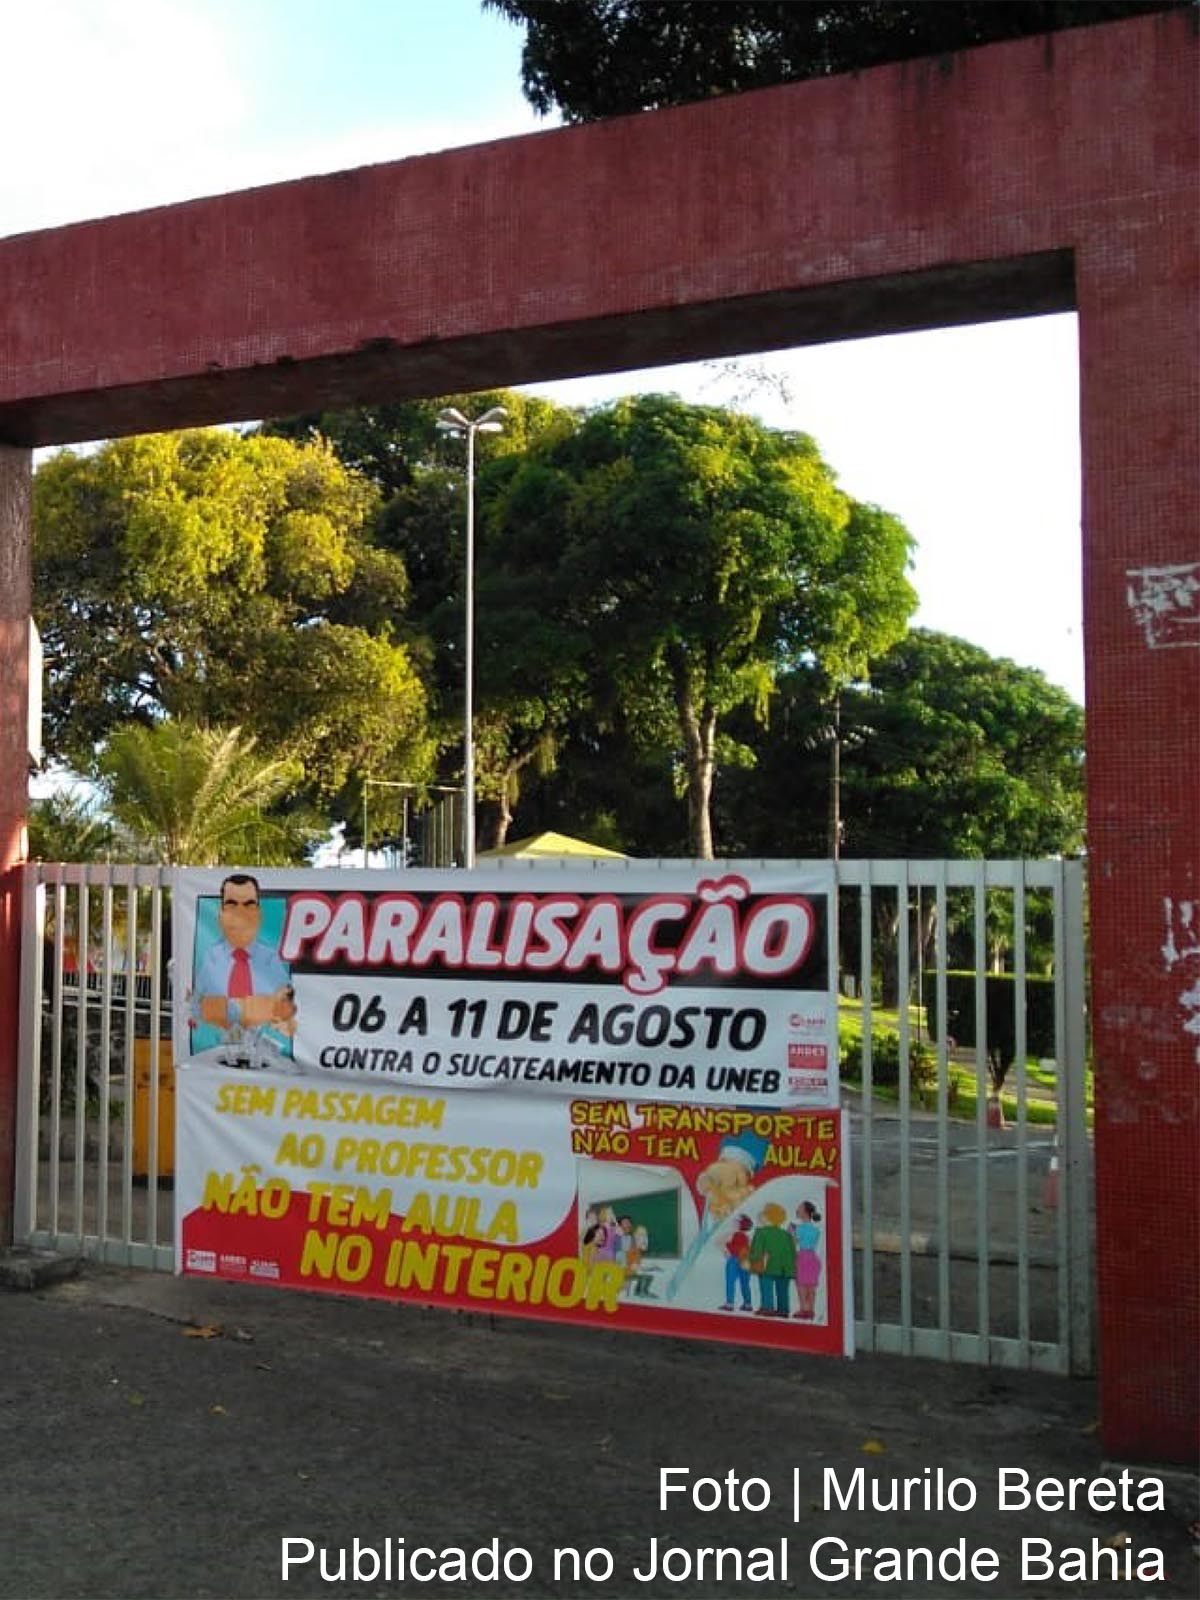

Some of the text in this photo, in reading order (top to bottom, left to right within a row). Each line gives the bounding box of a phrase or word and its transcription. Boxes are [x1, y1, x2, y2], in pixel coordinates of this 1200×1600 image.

[280, 876, 813, 992] PARALISAÇÃO
[332, 993, 767, 1051] 06 A 11 DE AGOSTO
[320, 1046, 412, 1073] CONTRA
[422, 1052, 442, 1075] O
[447, 1053, 651, 1087] SUCATEAMENTO
[658, 1063, 696, 1090] DA
[706, 1067, 780, 1094] UNEB
[215, 1084, 447, 1131] SEM PASSAGEM
[570, 1100, 836, 1141] SEM TRANSPORTE
[275, 1133, 544, 1190] AO PROFESSOR
[571, 1128, 838, 1171] NÃO TEM AULA!
[203, 1163, 520, 1243] NÃO TEM AULA
[299, 1229, 626, 1312] NO INTERIOR
